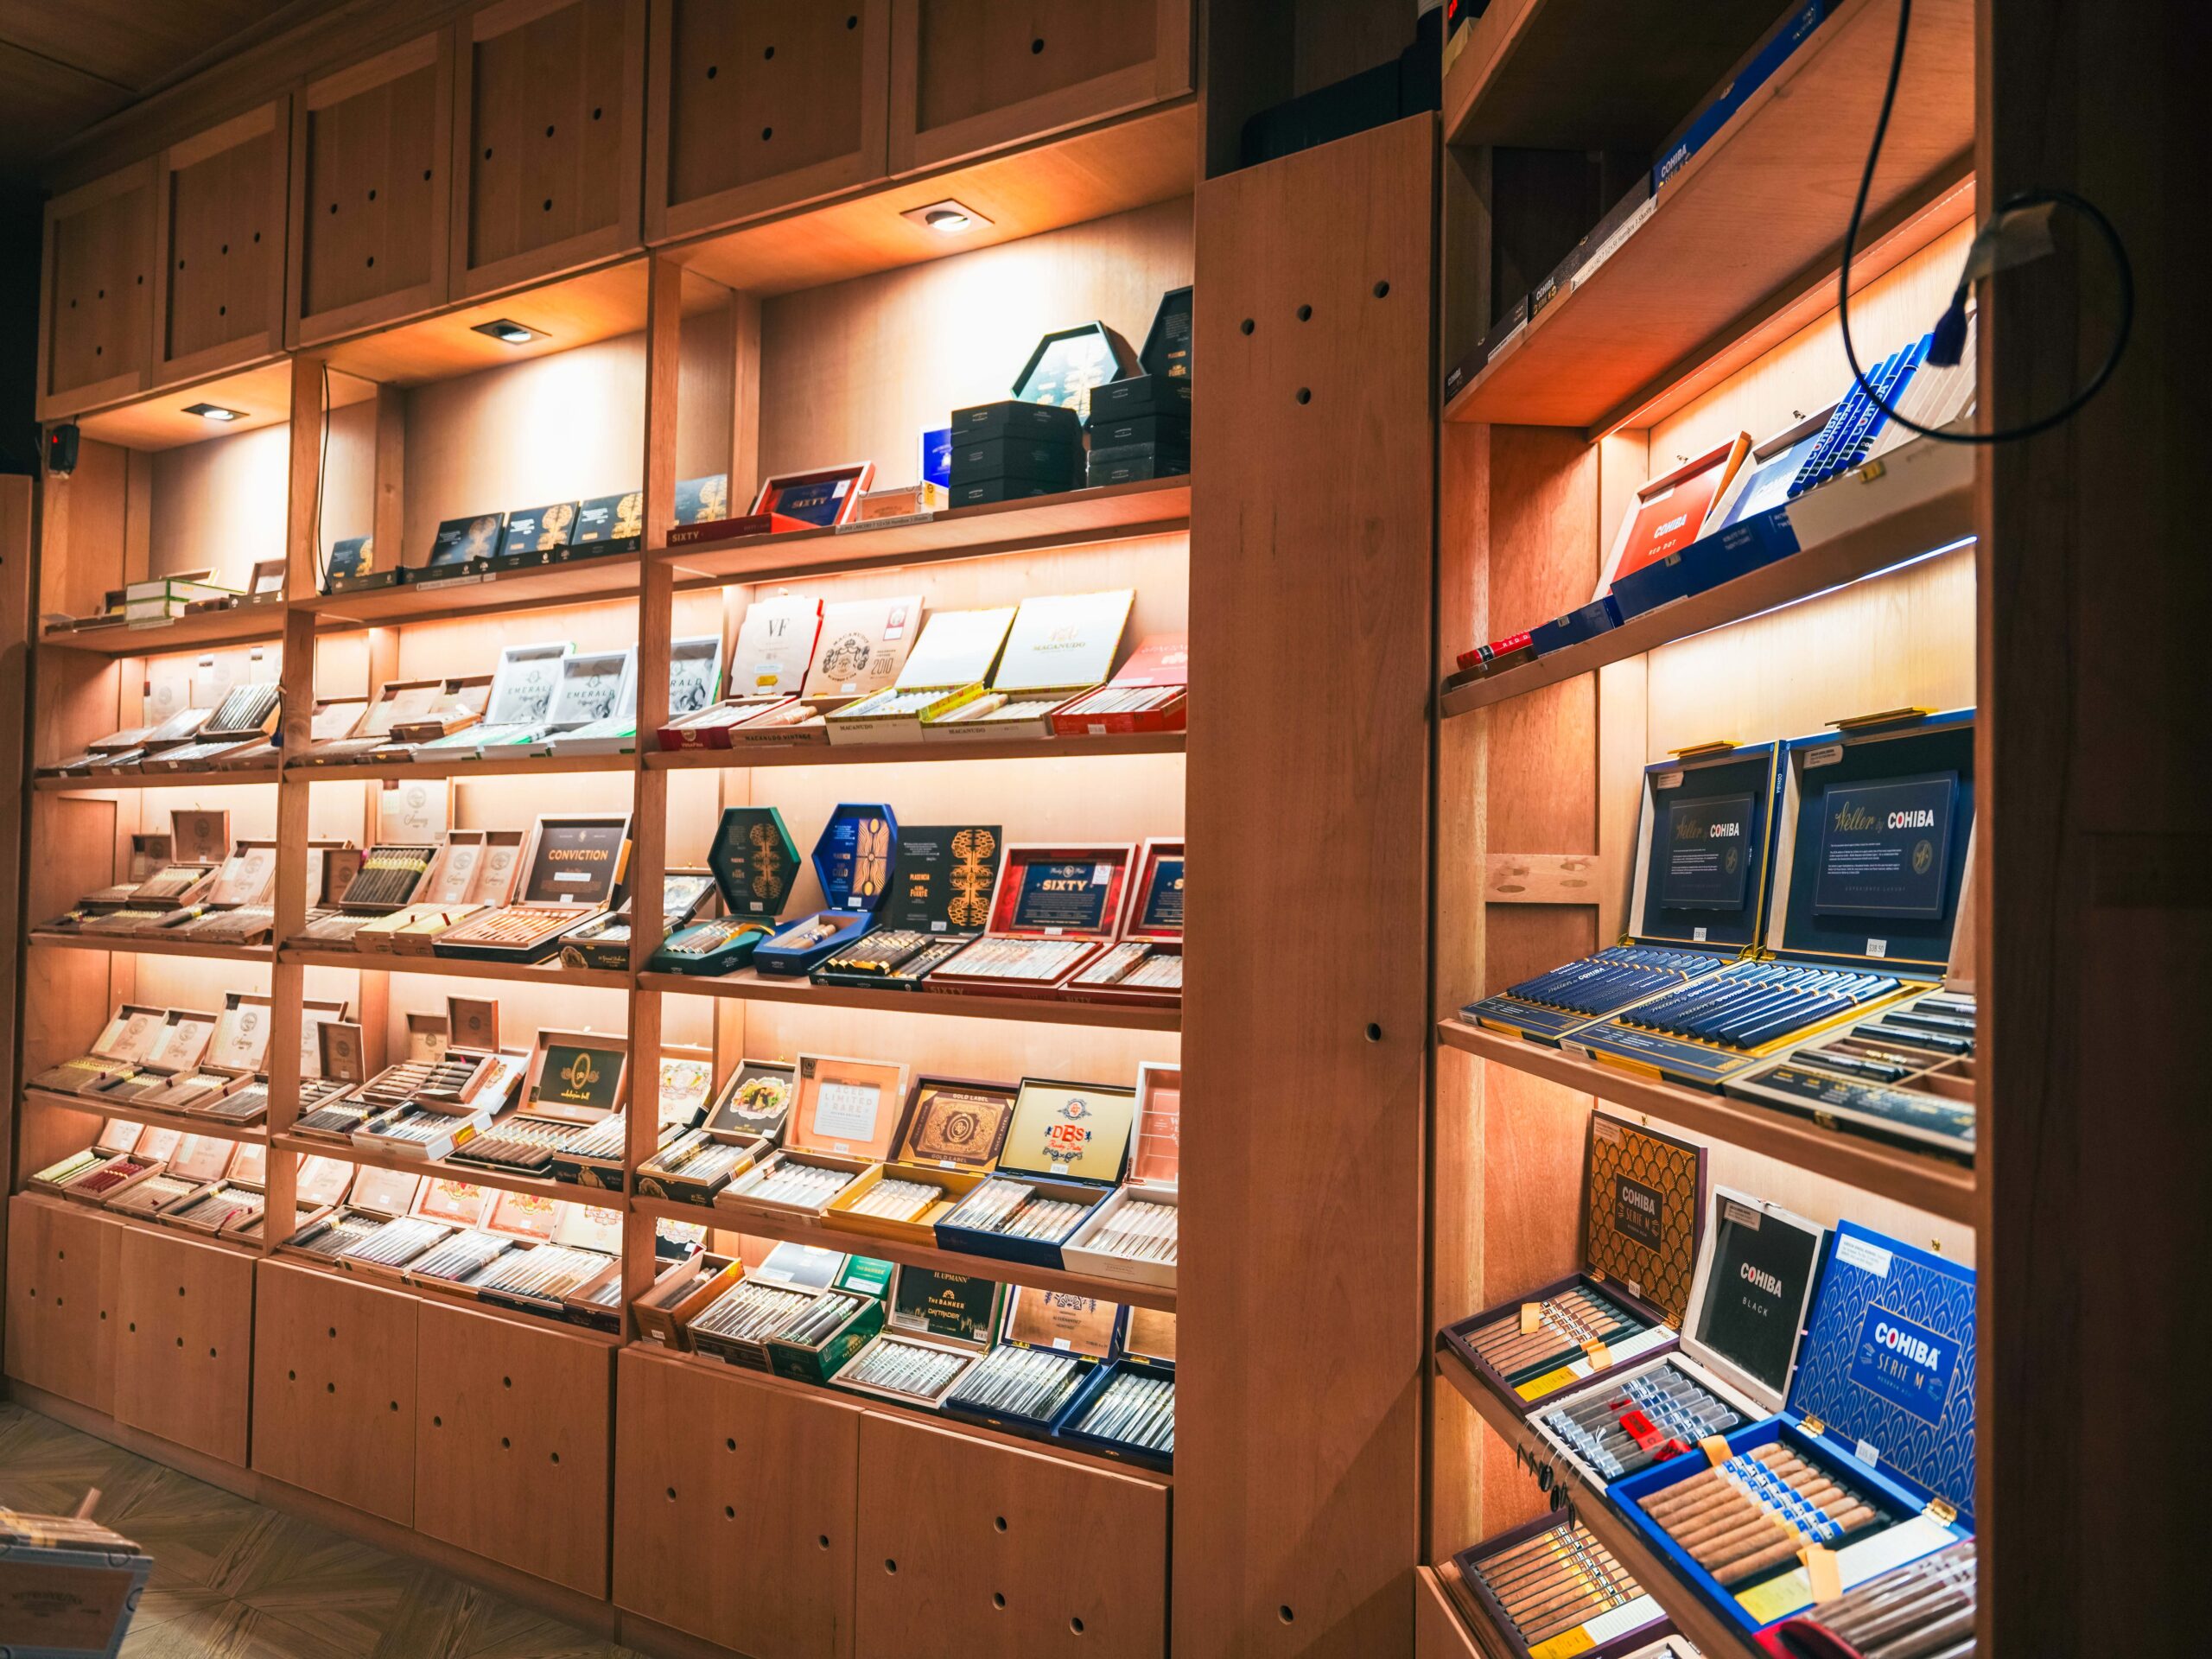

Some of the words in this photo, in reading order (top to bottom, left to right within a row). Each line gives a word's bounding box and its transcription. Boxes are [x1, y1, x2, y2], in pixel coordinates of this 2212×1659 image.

[1661, 143, 1687, 178] COHIBA
[1536, 276, 1554, 301] COHIBA
[1853, 384, 1889, 435] COHA
[1808, 411, 1842, 460] COHIBA
[792, 497, 827, 509] SIXTY
[1654, 513, 1687, 539] COHIBA
[671, 531, 699, 543] SIXTY
[1649, 546, 1661, 556] RED
[1662, 539, 1676, 551] DOT
[768, 618, 790, 637] VF
[832, 632, 869, 646] MACANUDO
[1503, 636, 1519, 648] RED
[1033, 642, 1086, 652] MACANUDO
[871, 657, 894, 676] 2010
[671, 677, 702, 688] RALD
[567, 689, 615, 699] EMERALD
[745, 734, 782, 742] MACANUDO
[1834, 801, 1874, 832] Weller
[1887, 809, 1935, 830] COHIBA
[1710, 822, 1740, 838] COHIBA
[548, 849, 609, 861] CONVICTION
[1042, 880, 1089, 891] SIXTY
[1868, 944, 1885, 953] $38.50
[1578, 967, 1605, 981] COHIBA
[930, 986, 963, 995] SIXTY
[836, 1085, 865, 1096] AGED
[824, 1093, 873, 1106] LIMITED
[832, 1103, 862, 1114] RARE
[1052, 1124, 1085, 1142] DBS
[1622, 1185, 1656, 1216] COHIBA
[1625, 1207, 1643, 1227] SERIE
[1644, 1217, 1649, 1230] M
[941, 1272, 968, 1283] UPMANN
[1740, 1262, 1782, 1298] COHIBA
[938, 1300, 965, 1310] BANKER
[1742, 1296, 1768, 1317] BLACK
[927, 1307, 960, 1321] DAYTRADER
[1875, 1322, 1938, 1372] COHIBA
[1877, 1352, 1910, 1382] SERIE
[1914, 1371, 1925, 1390] M
